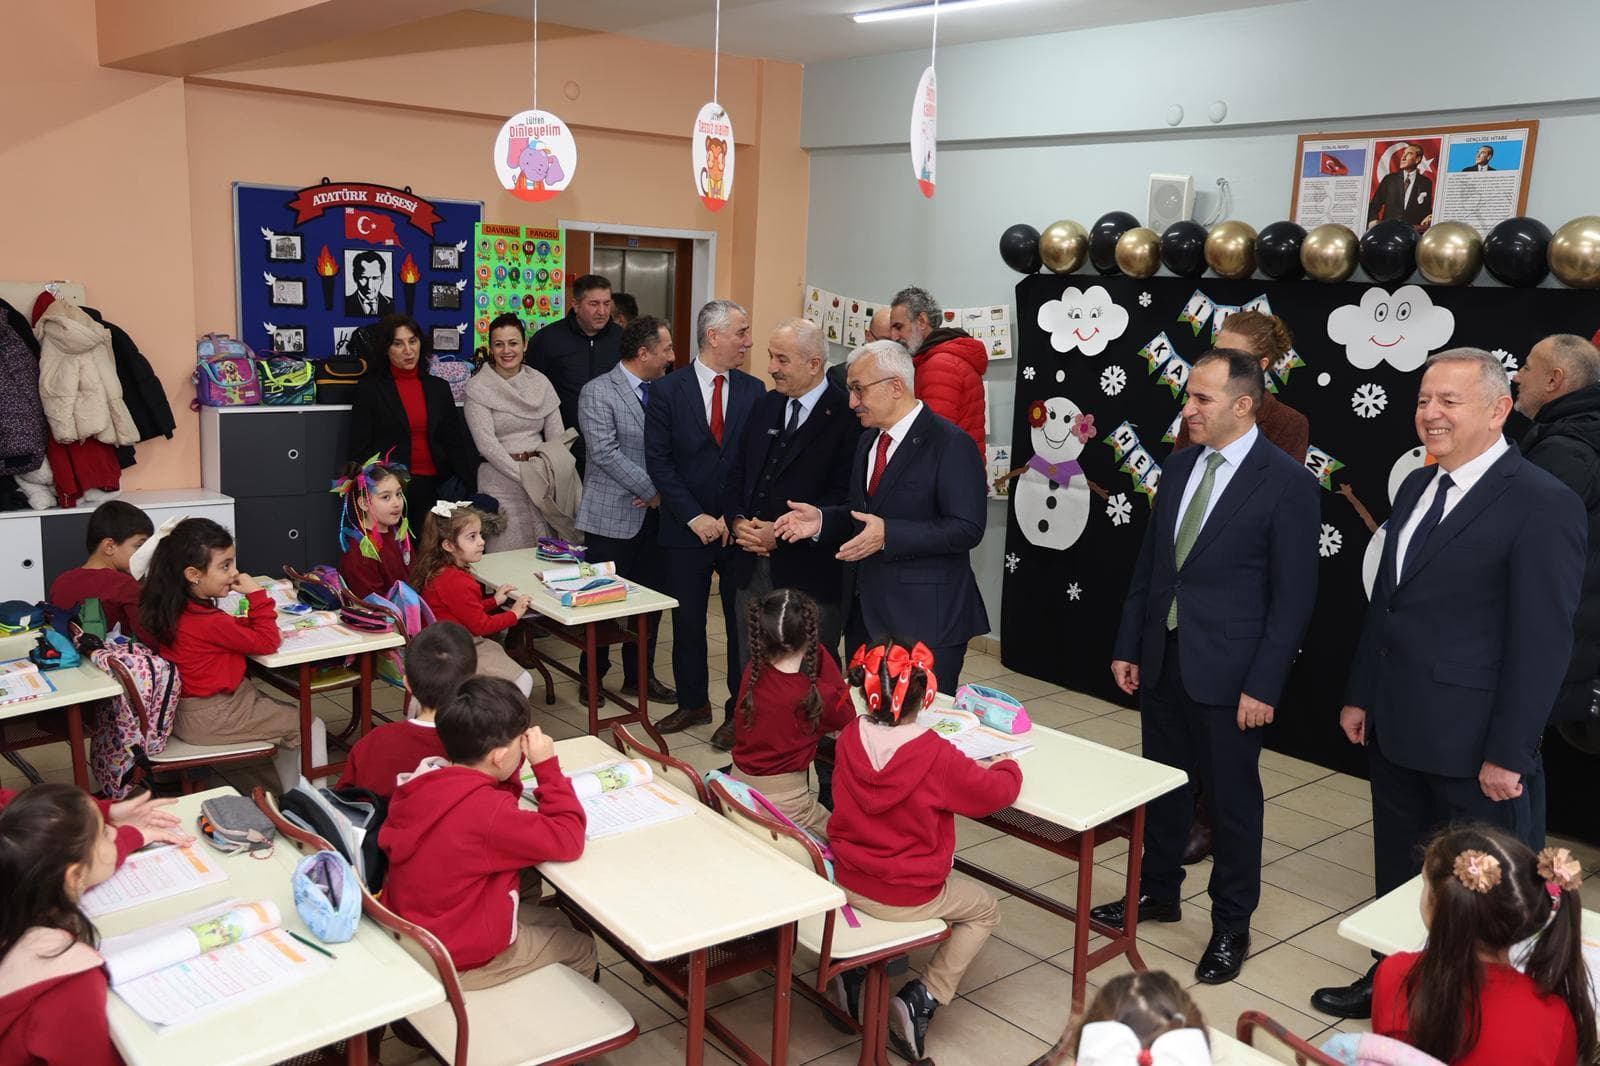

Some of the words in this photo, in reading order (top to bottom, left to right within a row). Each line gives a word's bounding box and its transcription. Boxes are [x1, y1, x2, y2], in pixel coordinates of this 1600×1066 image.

[526, 116, 545, 125] Lütfen
[509, 125, 561, 139] Dinleyelim
[313, 188, 368, 206] ATATÜRK
[375, 191, 418, 213] KÖŞESİ
[485, 225, 519, 237] DAVRANIŞ
[529, 229, 558, 239] PANOSU
